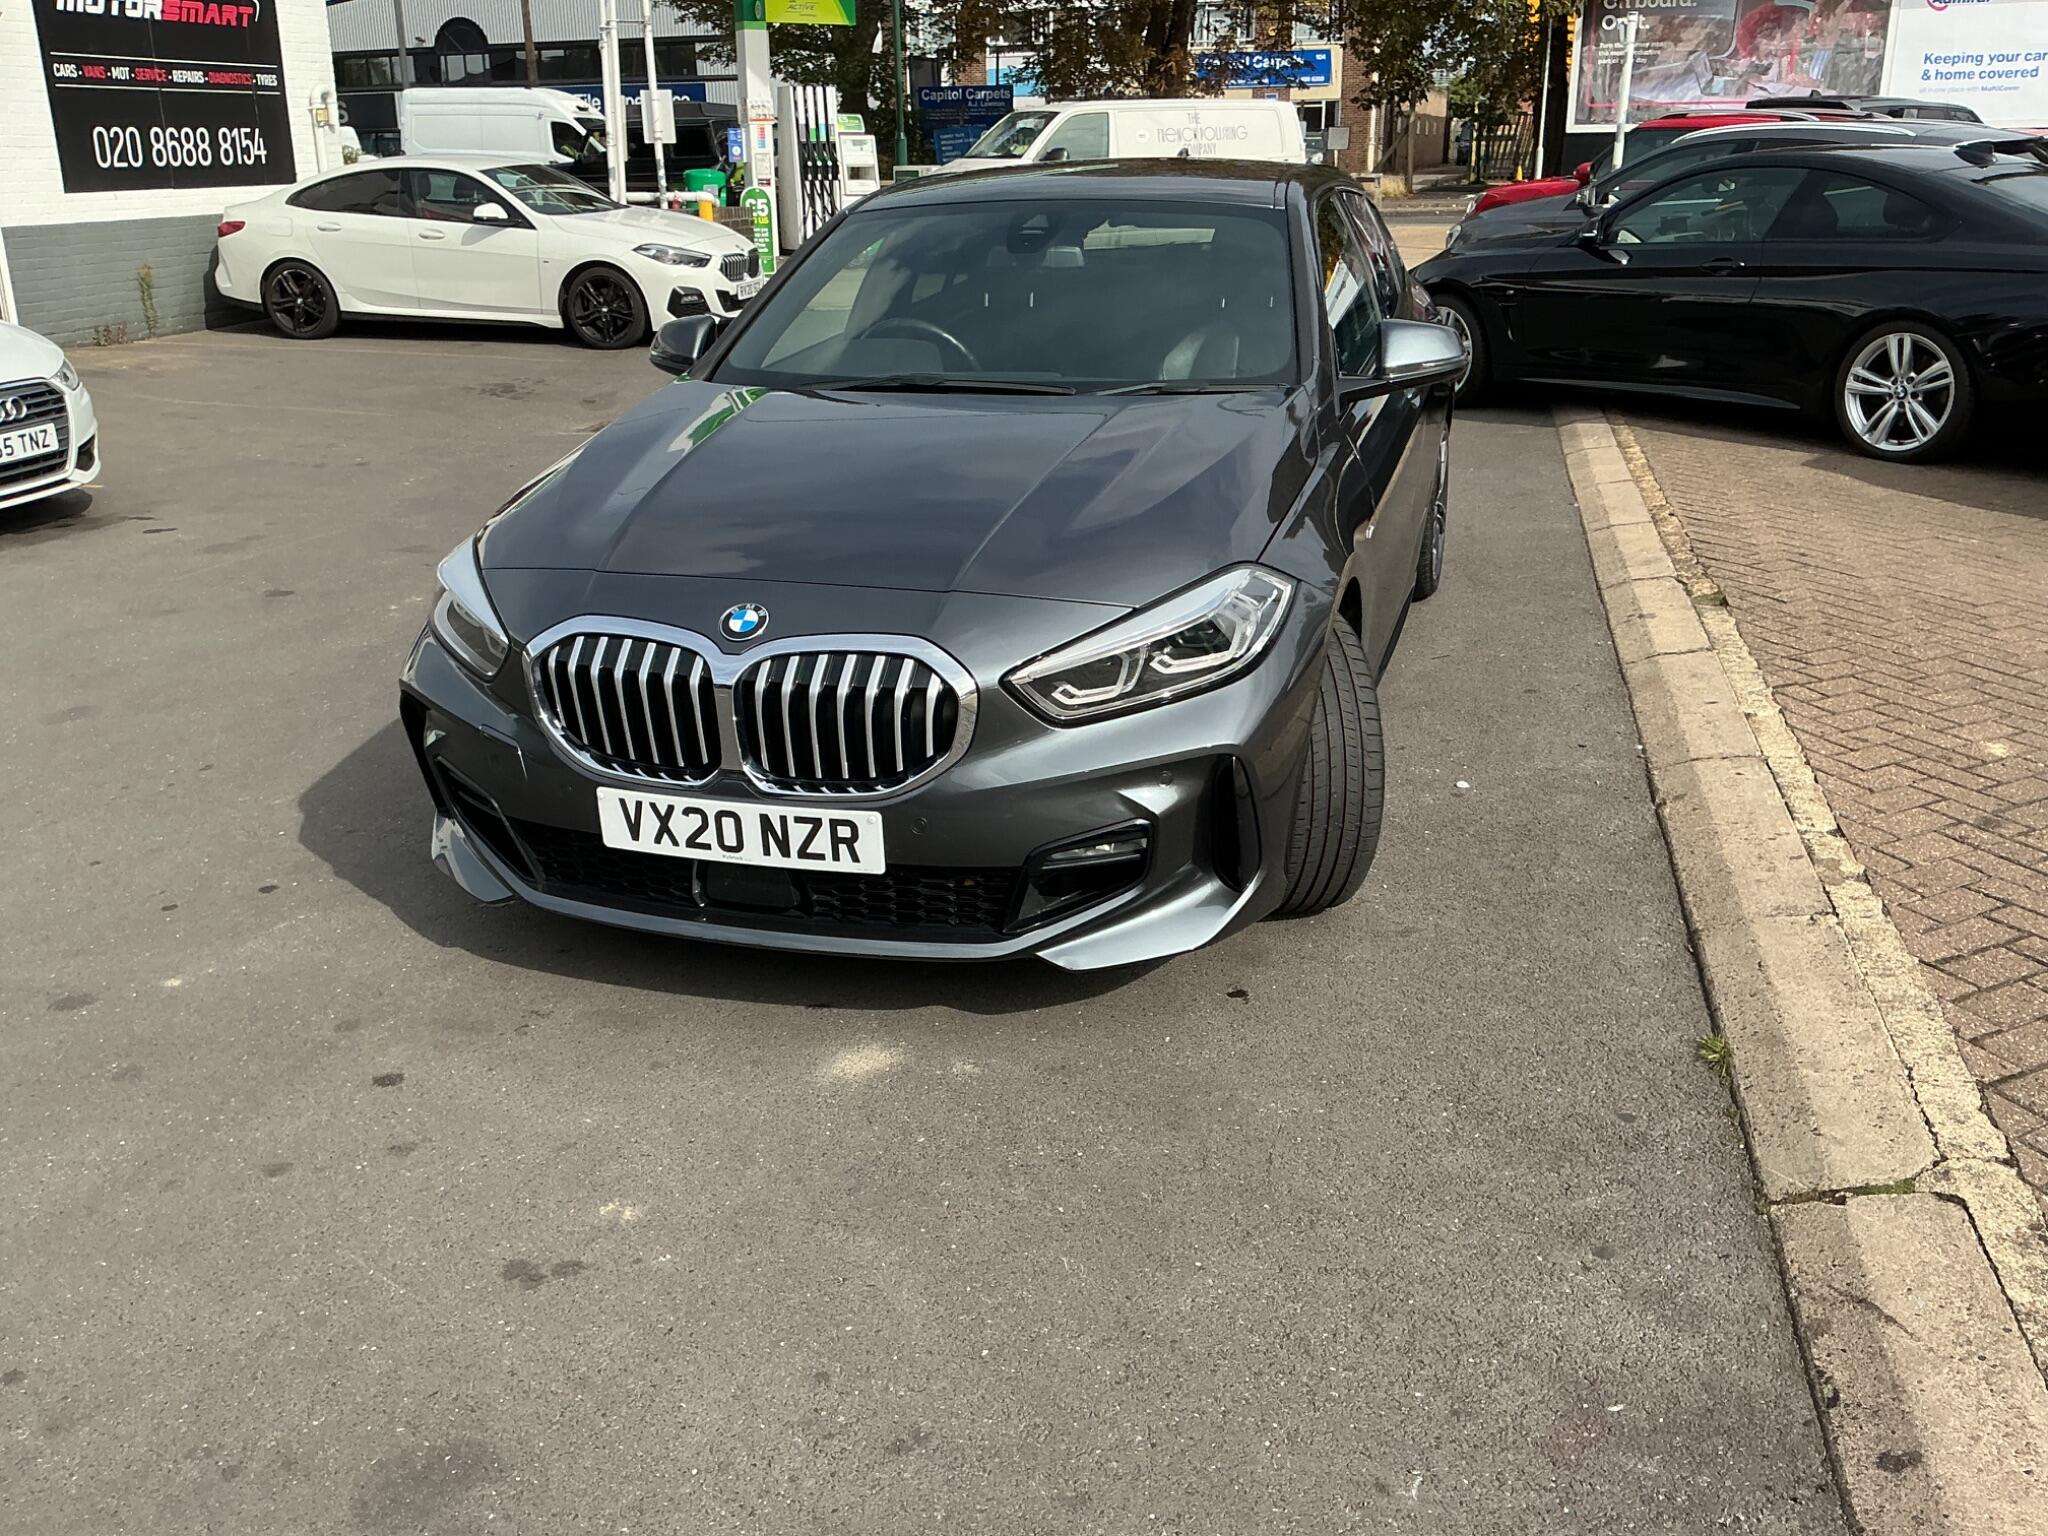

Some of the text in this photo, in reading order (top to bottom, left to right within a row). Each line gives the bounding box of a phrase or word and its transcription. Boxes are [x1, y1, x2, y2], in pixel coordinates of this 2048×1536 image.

[1924, 52, 2048, 66] Keeping your car
[53, 63, 77, 78] CARS
[82, 65, 105, 79] VANS
[112, 66, 130, 80] MOT
[135, 67, 167, 82] SERVICE
[172, 69, 204, 84] REPAIRS
[256, 73, 278, 87] TYRES
[1921, 66, 2040, 81] & home covered
[921, 88, 1011, 103] Capitol Carpets
[93, 126, 267, 168] 020 8688 8154
[17, 429, 50, 452] TNZ
[619, 797, 861, 864] VX20 NZR
